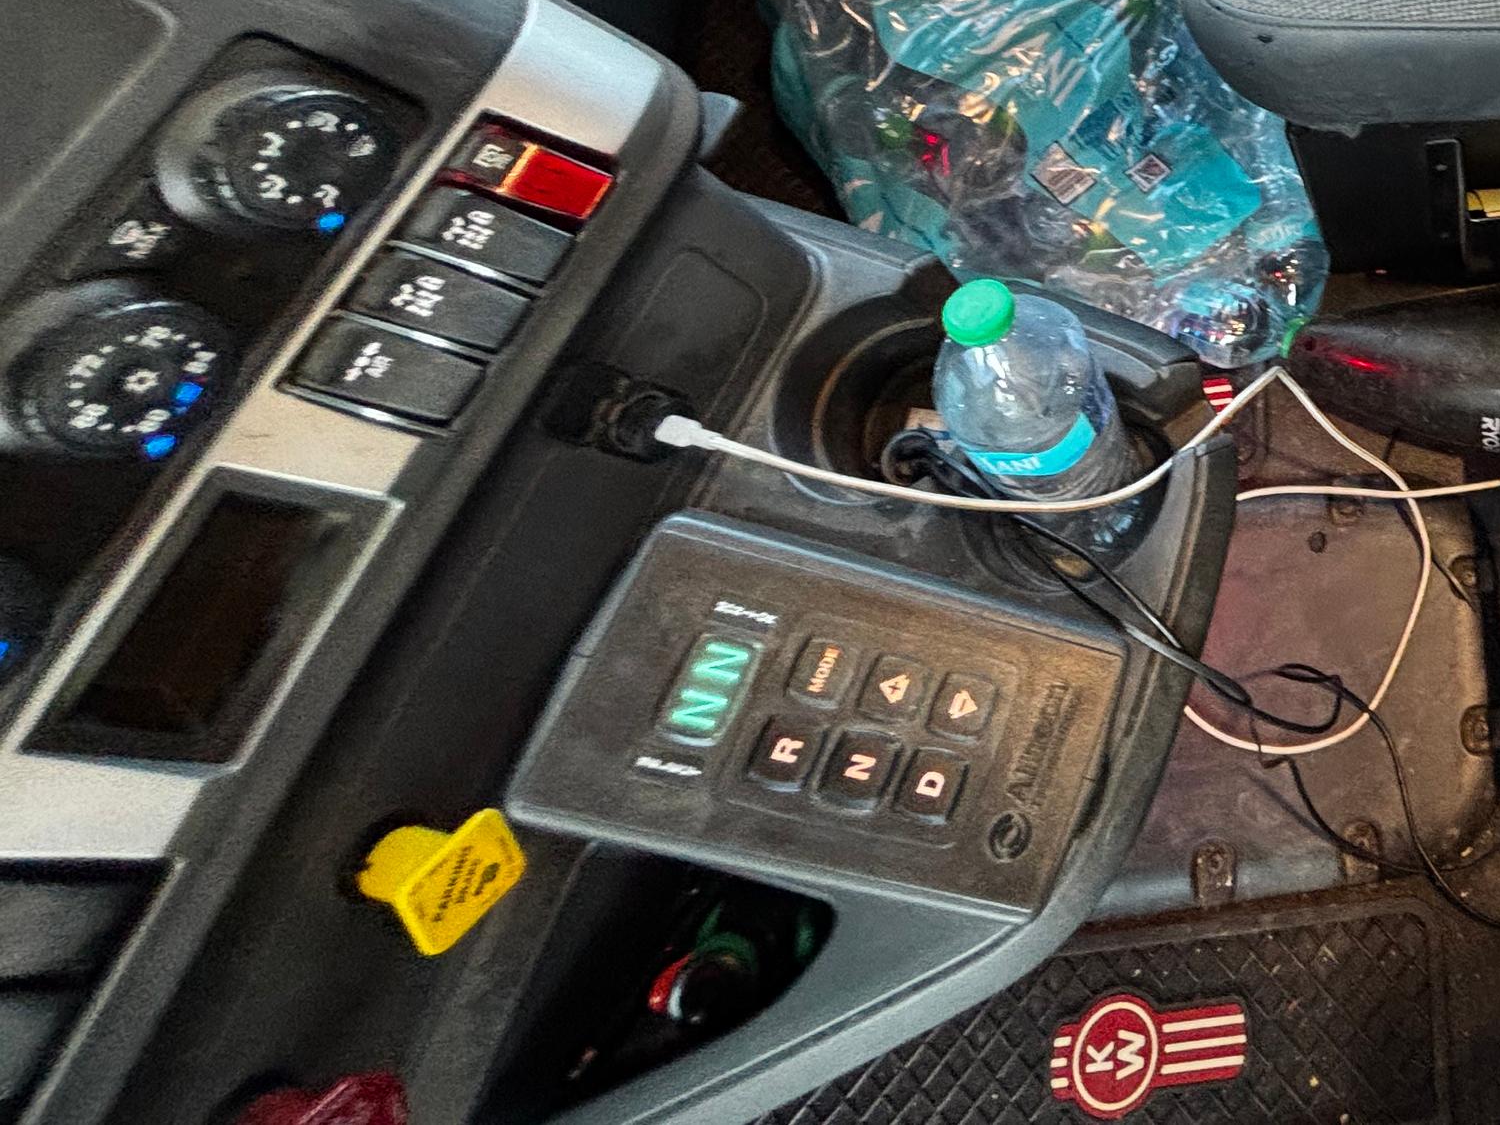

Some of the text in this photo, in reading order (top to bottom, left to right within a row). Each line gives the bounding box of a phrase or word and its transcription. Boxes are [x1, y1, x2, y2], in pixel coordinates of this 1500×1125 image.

[770, 737, 804, 764] R
[843, 753, 877, 781] N
[915, 771, 946, 798] D
